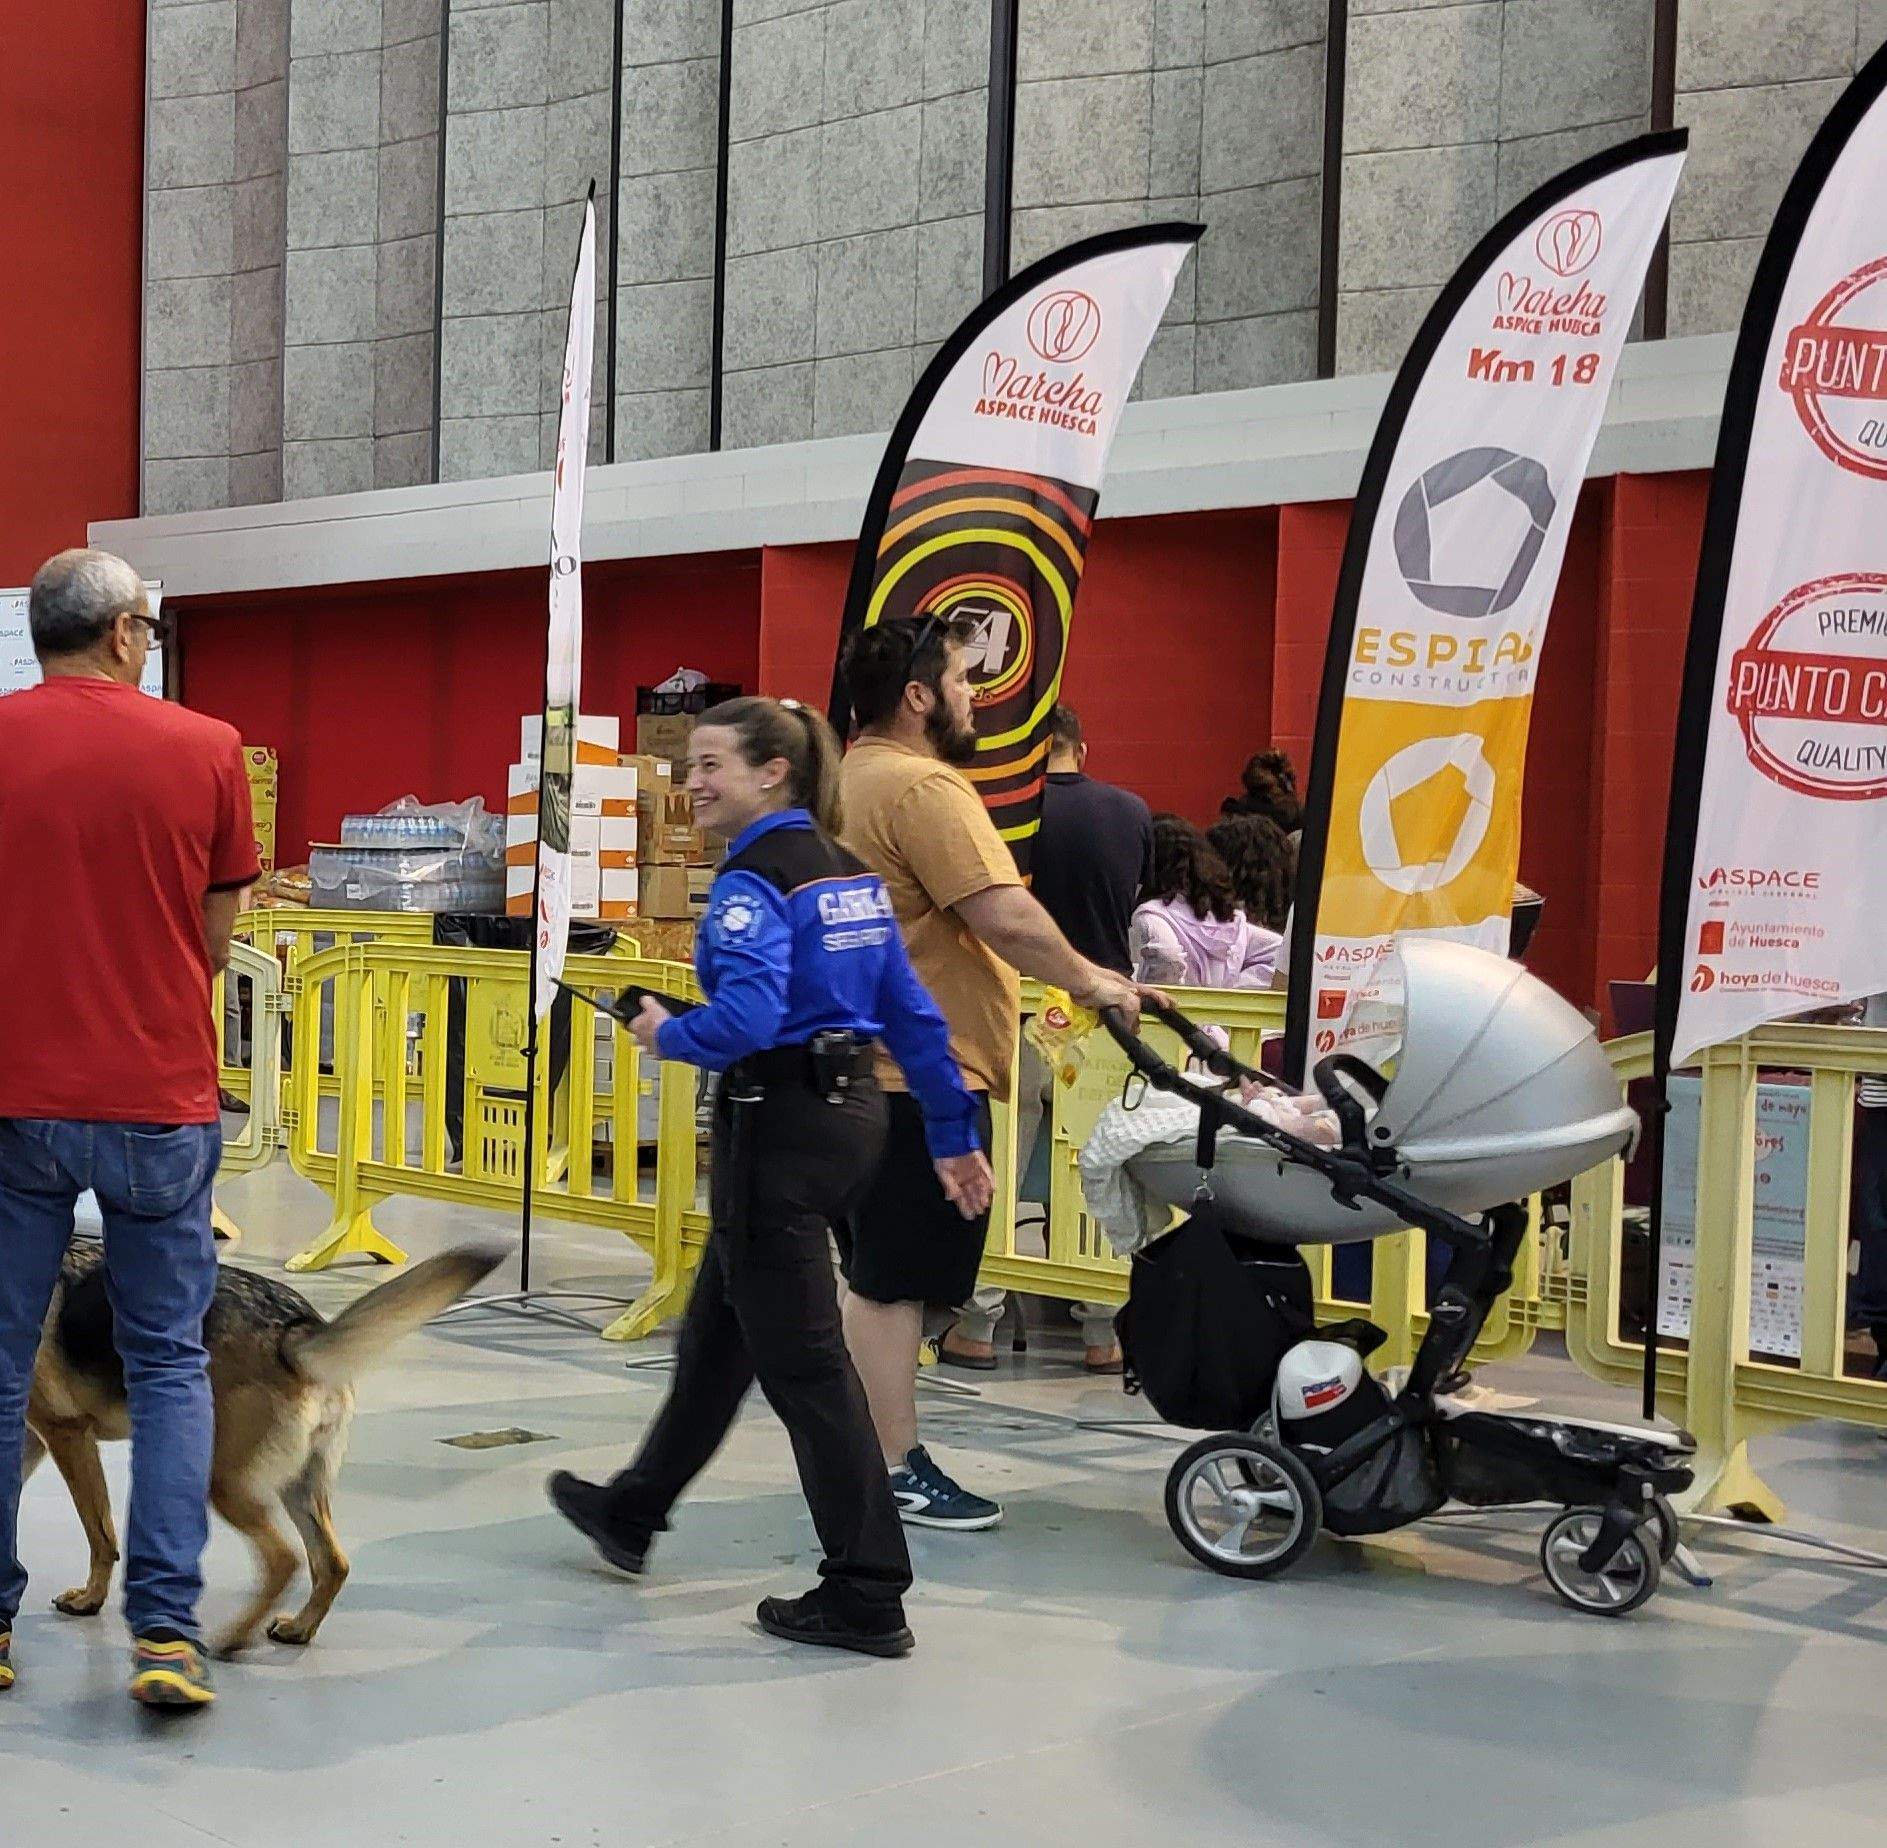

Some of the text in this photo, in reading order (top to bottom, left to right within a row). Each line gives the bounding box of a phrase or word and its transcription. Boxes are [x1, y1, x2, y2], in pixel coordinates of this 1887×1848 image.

[1498, 272, 1607, 318] Marcha
[982, 352, 1105, 416] Marcha
[1467, 348, 1600, 386] Km 18
[974, 398, 1097, 436] ASPACE HUESCA
[1735, 660, 1887, 720] PUNTO C
[1797, 739, 1887, 772] QUALITY
[1709, 867, 1821, 890] ASPACE
[1728, 936, 1800, 949] de Huesca
[1730, 921, 1825, 939] Ayuntamiento
[1720, 971, 1840, 992] hoya de huesca
